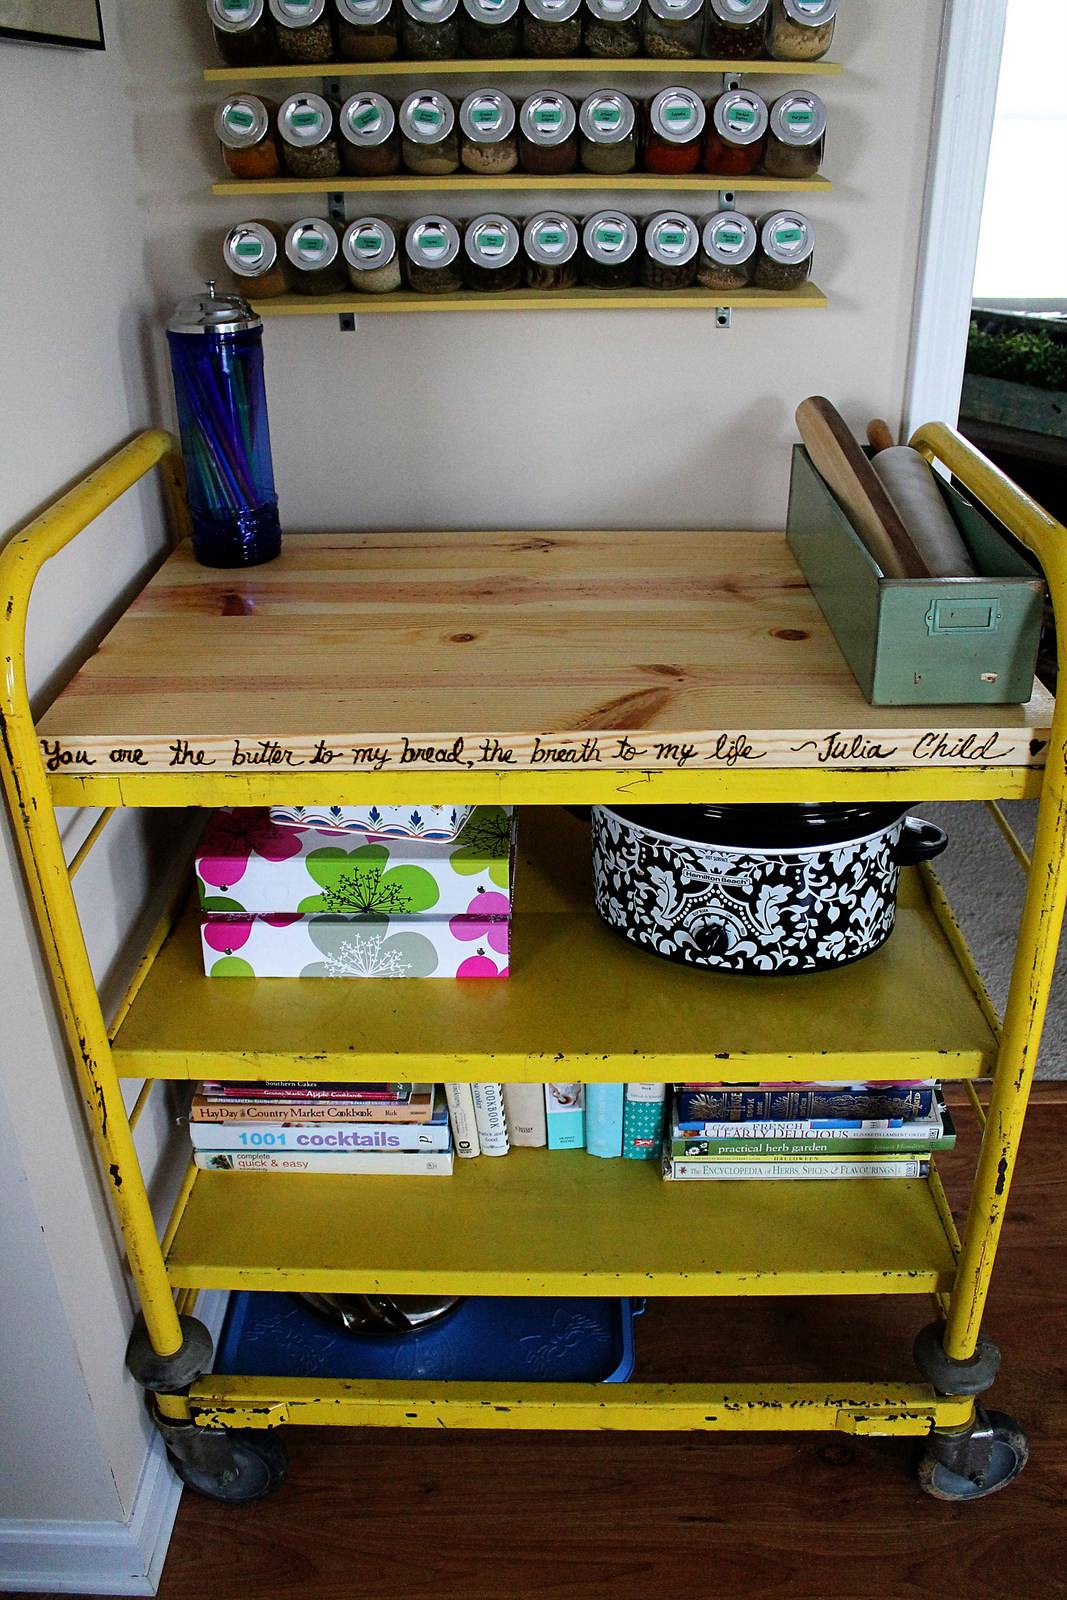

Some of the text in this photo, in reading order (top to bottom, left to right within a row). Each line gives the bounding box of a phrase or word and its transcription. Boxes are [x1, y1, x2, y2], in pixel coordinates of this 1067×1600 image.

[912, 731, 1015, 761] Child
[40, 734, 767, 770] You are the butter to my bread, the breath to my life
[686, 871, 746, 885] Hamilton Beach
[306, 1090, 329, 1098] Apple
[474, 1090, 483, 1109] cooker
[484, 1085, 500, 1129] COOKBOOK
[247, 1107, 288, 1119] Country
[290, 1108, 325, 1117] Market
[328, 1107, 373, 1117] Cookbook
[753, 1123, 803, 1131] FRENCH
[239, 1131, 400, 1146] 1001 cocktails
[704, 1129, 849, 1138] CLEARLY DELICIOUS
[718, 1143, 827, 1154] practical herb garden
[237, 1153, 271, 1161] complete
[238, 1160, 267, 1168] quick
[283, 1161, 309, 1169] easy
[703, 1166, 762, 1175] ENCYCLOPEDIA
[802, 1166, 829, 1175] SPICES
[830, 1166, 838, 1174] &
[840, 1165, 895, 1175] FLAVOURINGS
